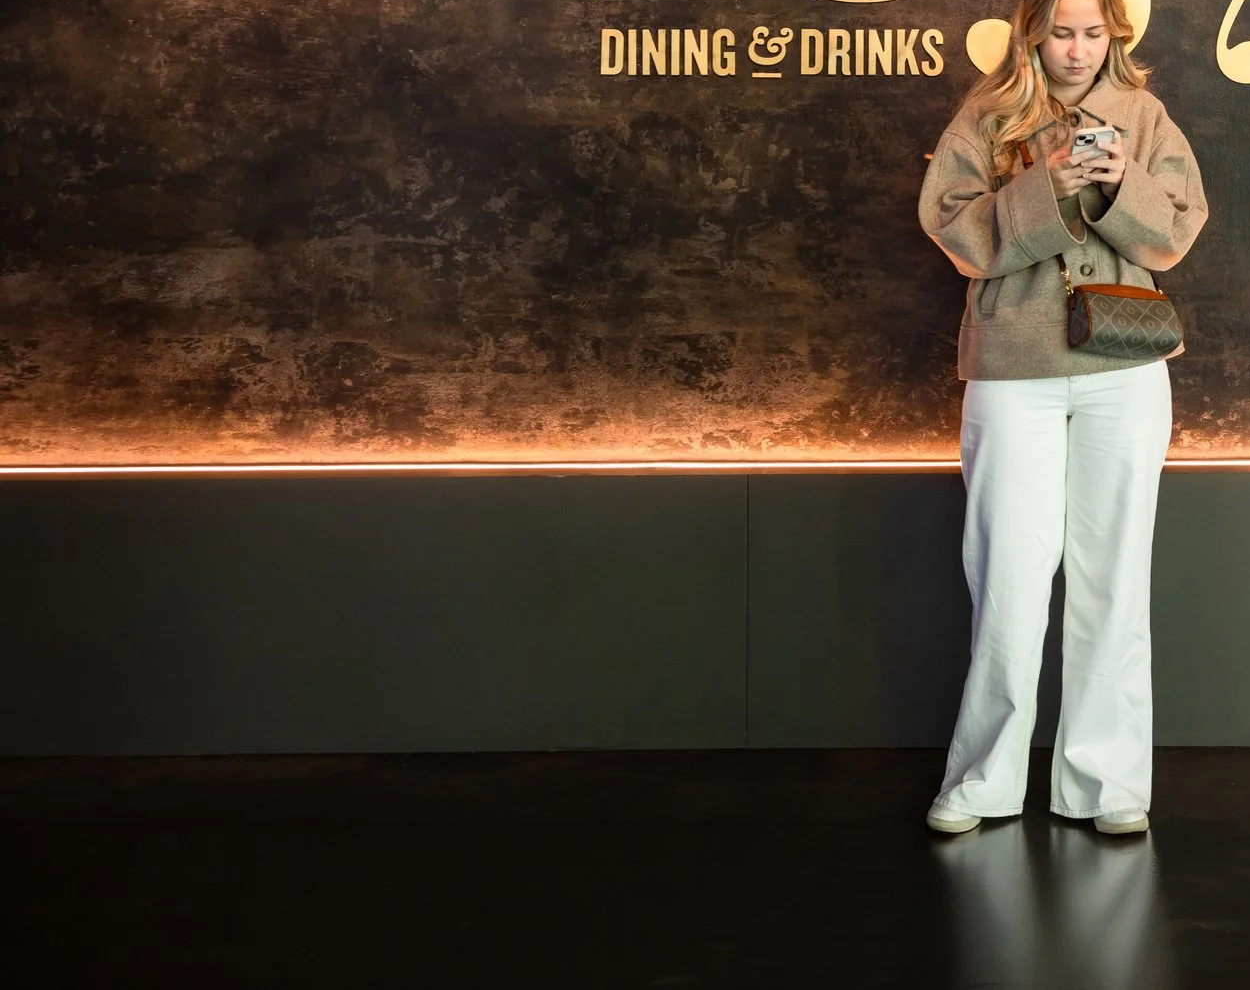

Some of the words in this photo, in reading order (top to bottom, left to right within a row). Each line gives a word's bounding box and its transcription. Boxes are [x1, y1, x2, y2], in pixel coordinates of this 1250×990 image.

[600, 28, 737, 76] DINING
[747, 26, 794, 78] &
[800, 28, 944, 76] DRINKS
